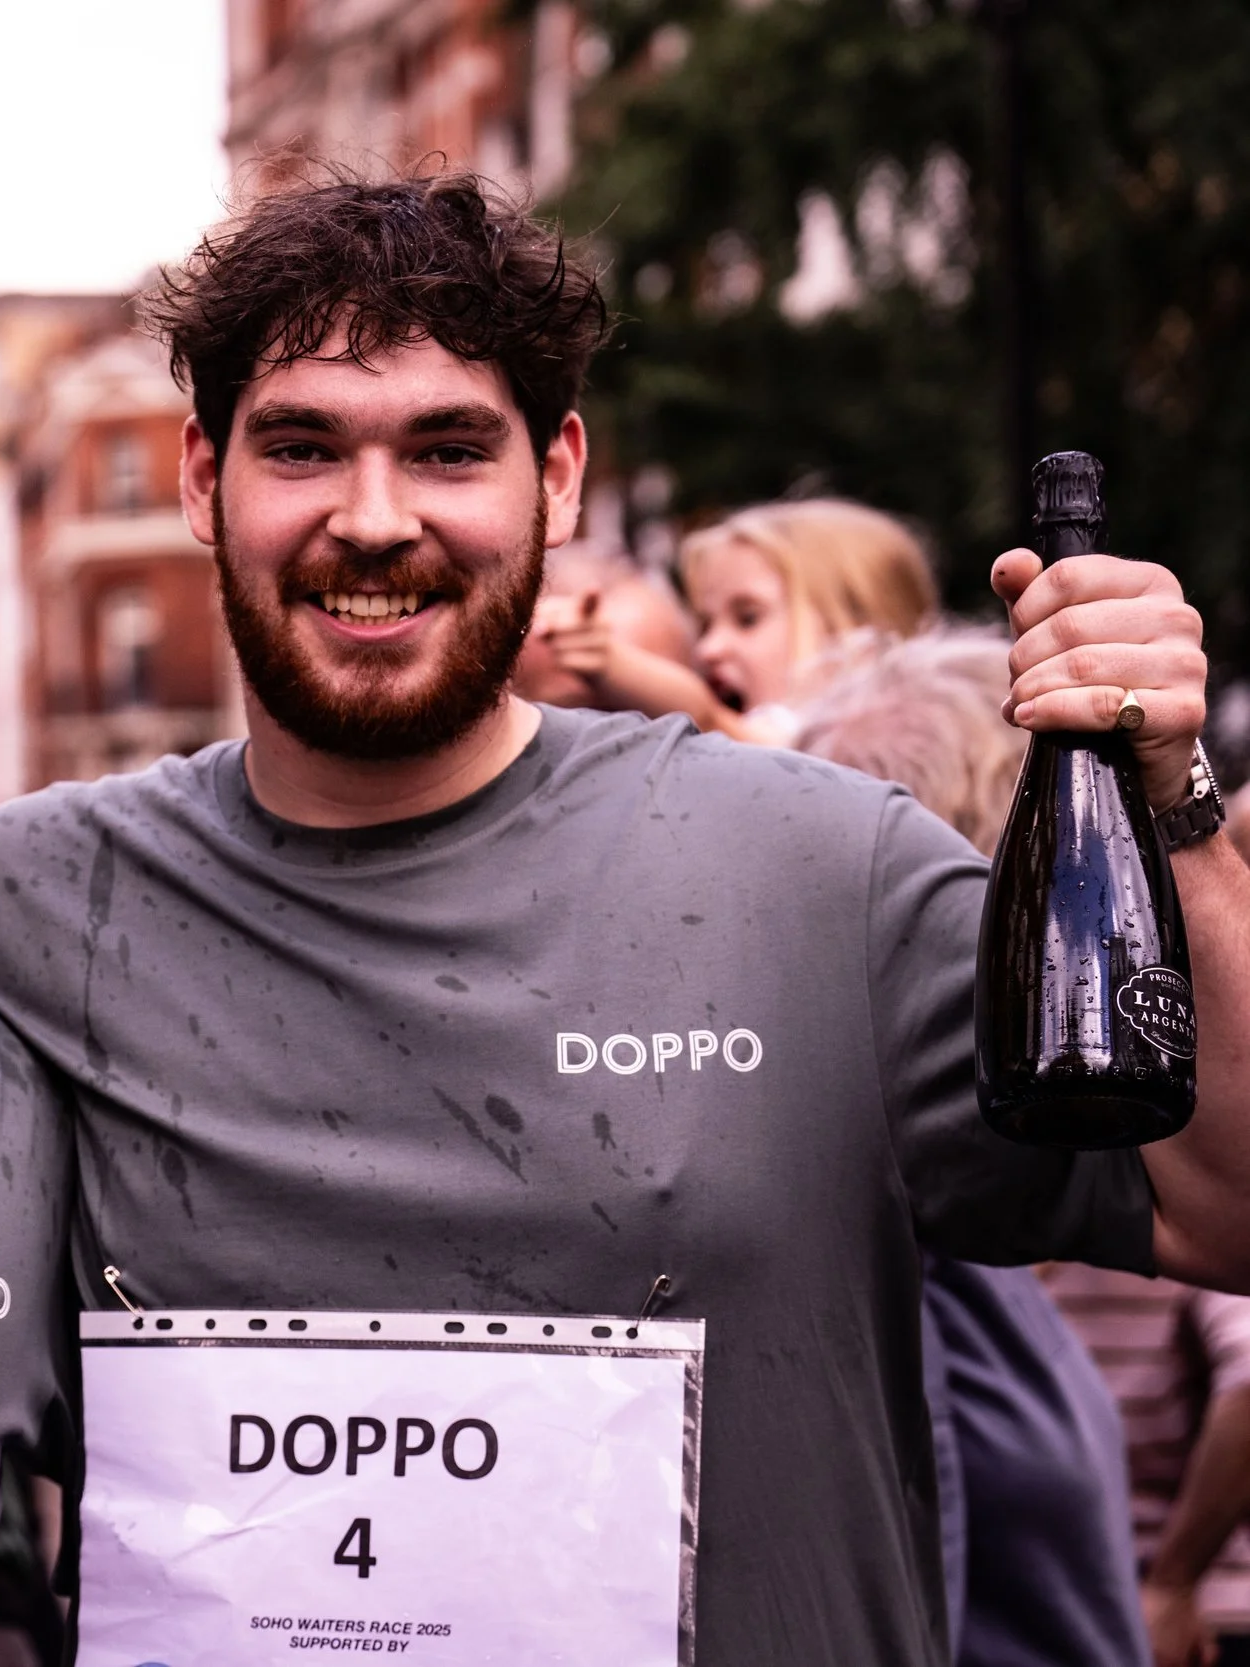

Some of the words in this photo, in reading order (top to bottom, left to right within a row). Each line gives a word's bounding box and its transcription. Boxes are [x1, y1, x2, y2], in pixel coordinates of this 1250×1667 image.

[1133, 990, 1196, 1028] LUNA
[556, 1028, 763, 1075] DOPPO
[229, 1414, 499, 1480] DOPPO
[334, 1517, 377, 1579] 4
[250, 1616, 293, 1630] SOHO
[297, 1618, 366, 1633] WAITERS
[369, 1620, 413, 1635] RACE
[416, 1623, 452, 1637] 2025
[289, 1636, 383, 1652] SUPPORTED
[387, 1640, 410, 1653] BY
